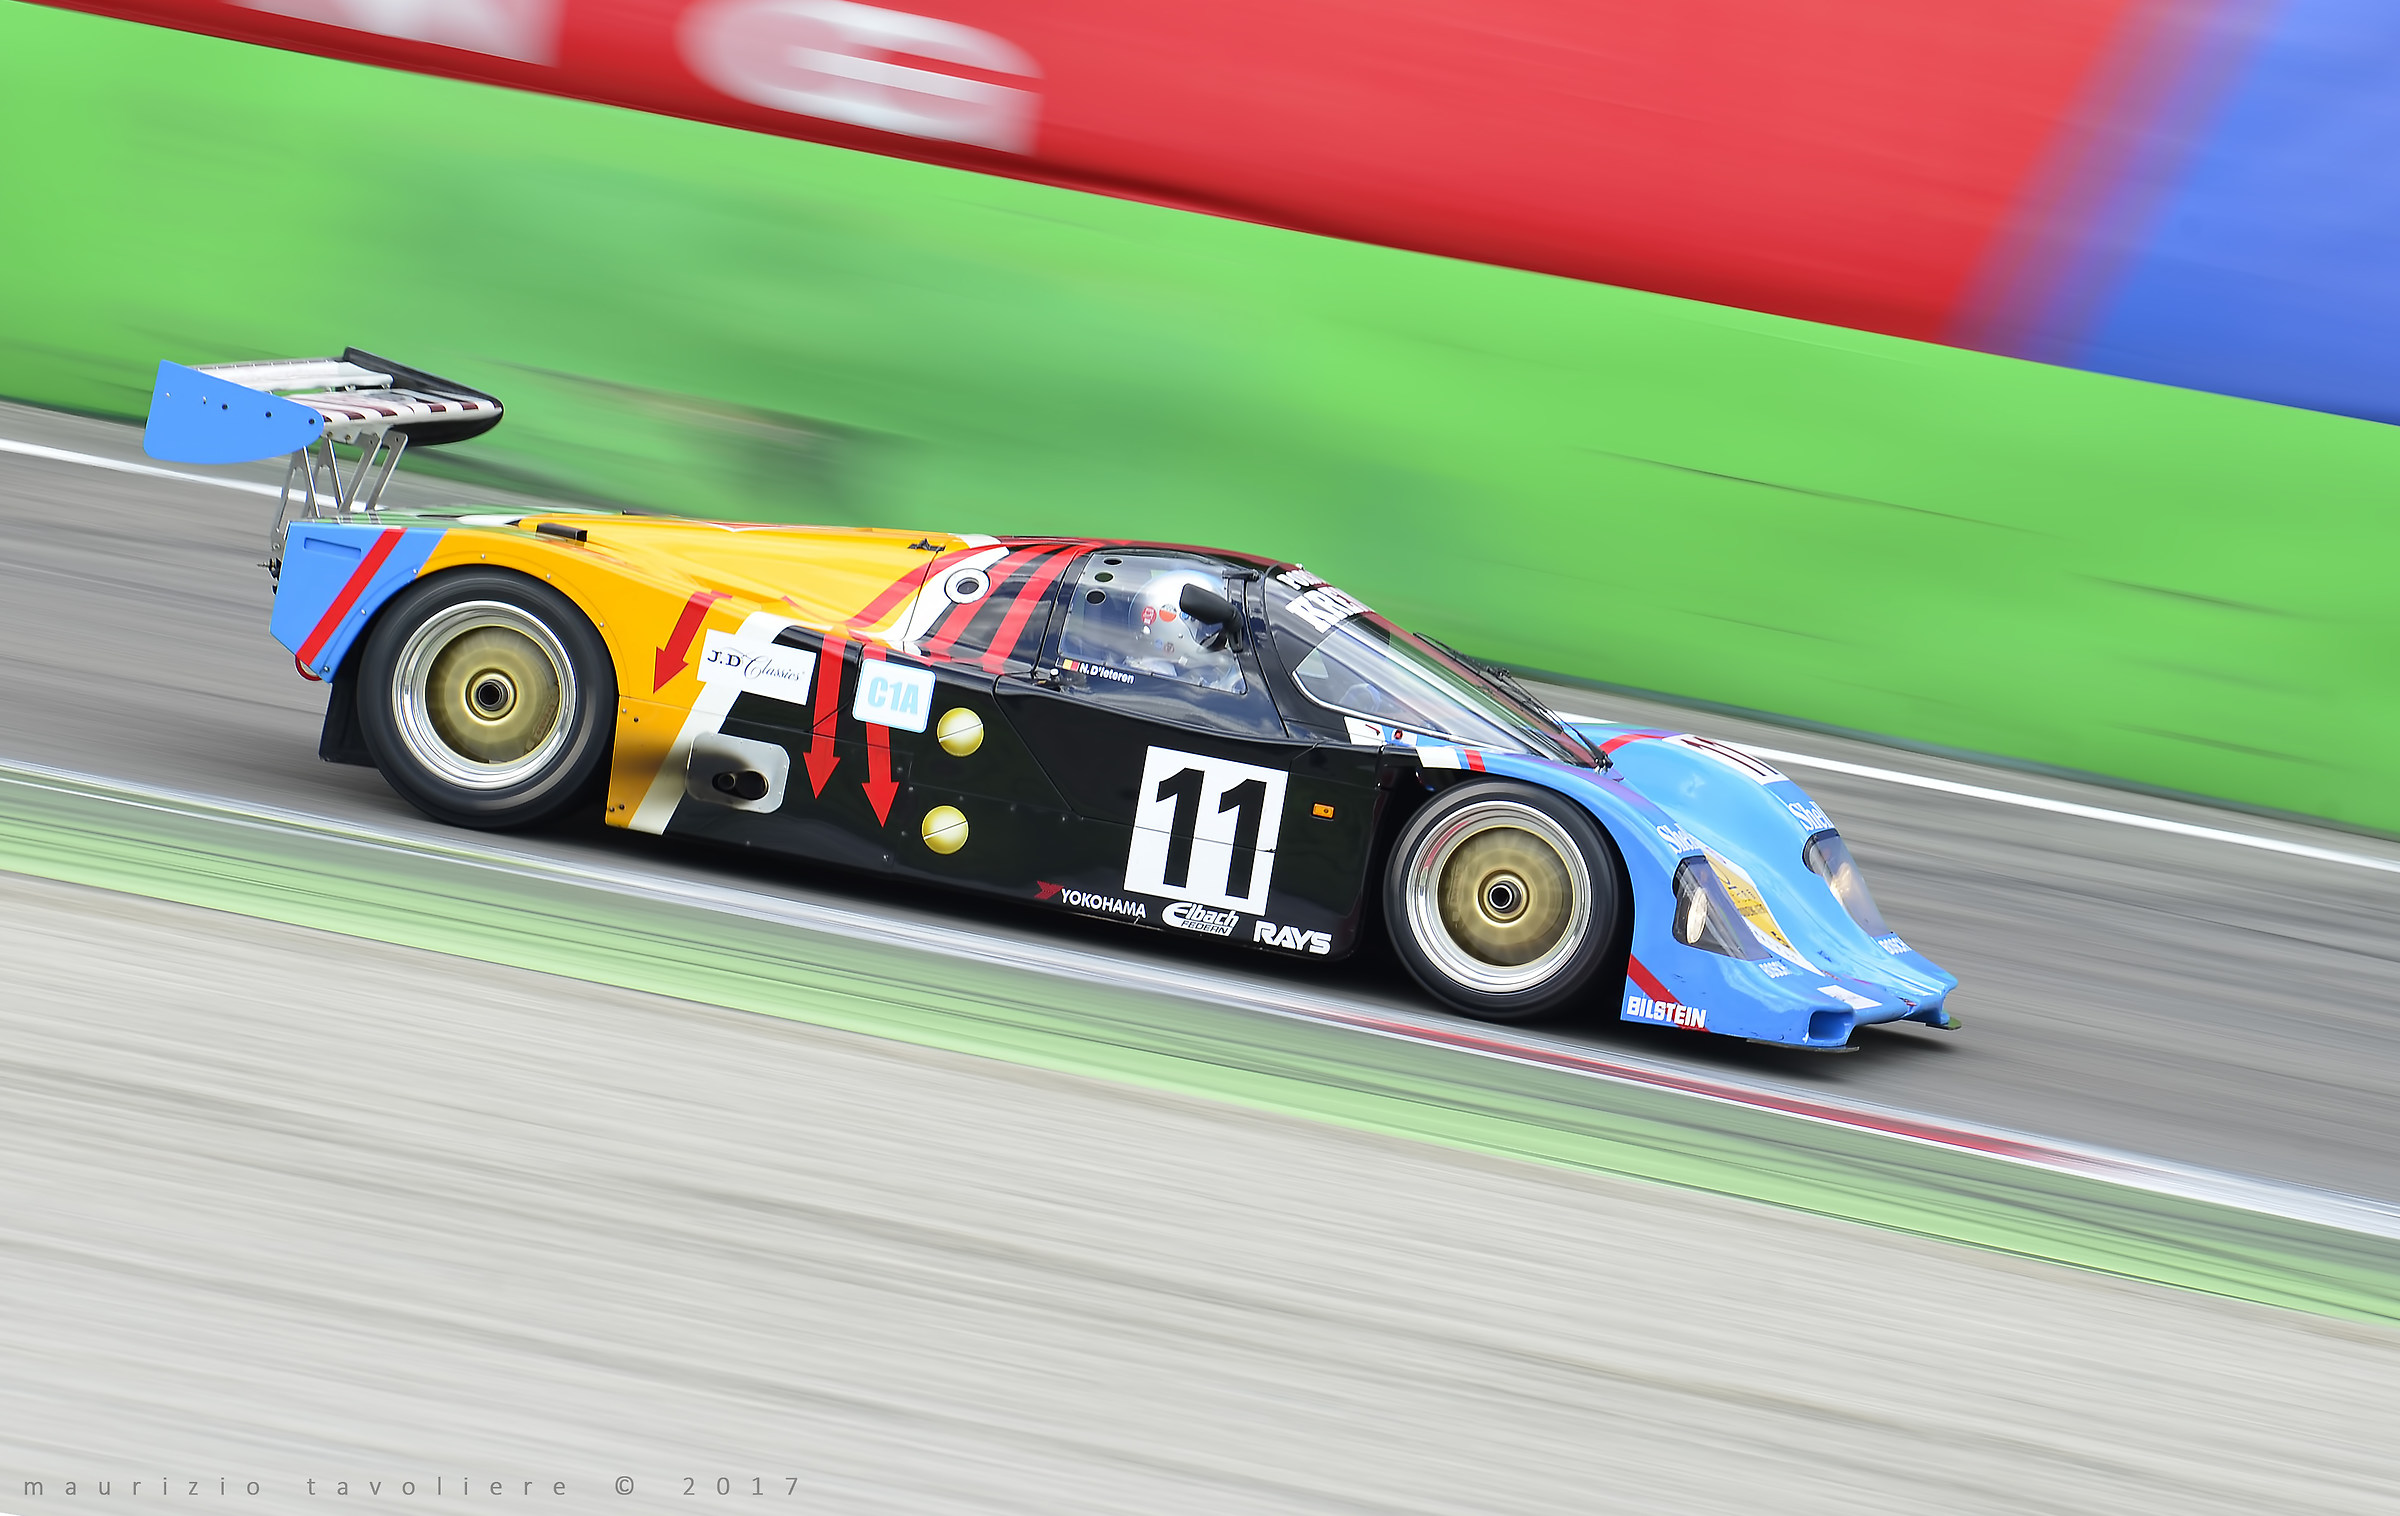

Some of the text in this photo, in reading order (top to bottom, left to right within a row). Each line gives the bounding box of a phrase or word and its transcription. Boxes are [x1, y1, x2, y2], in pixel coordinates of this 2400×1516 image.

[707, 649, 801, 681] J.D Classics
[867, 676, 919, 716] C1A
[1788, 800, 1835, 832] Shell
[1155, 767, 1267, 900] 11
[1061, 888, 1147, 919] YOKOHAMA
[1180, 919, 1229, 935] FEDERN
[1253, 920, 1332, 955] RAYS
[1626, 995, 1707, 1029] BILSTEIN
